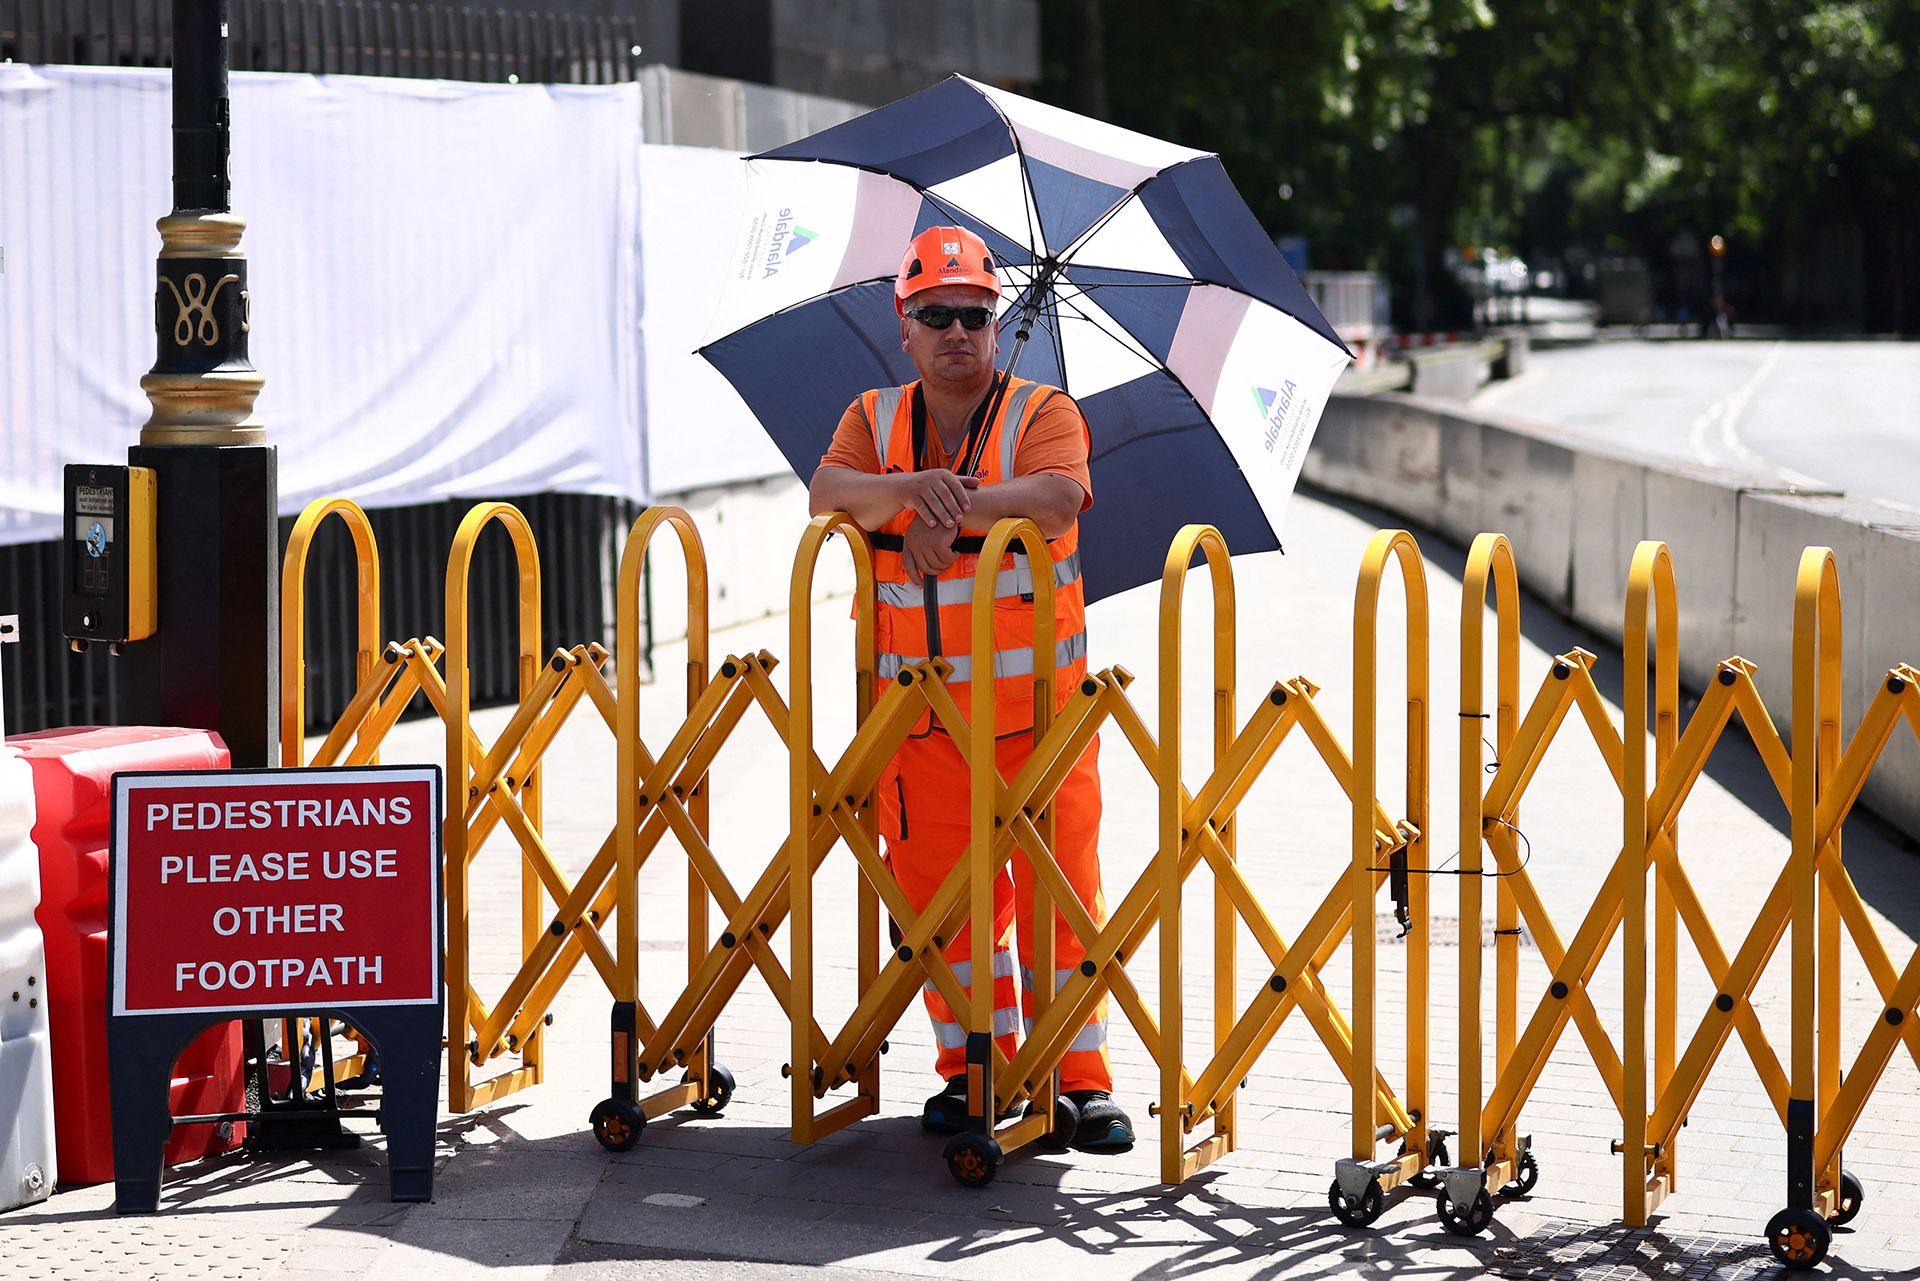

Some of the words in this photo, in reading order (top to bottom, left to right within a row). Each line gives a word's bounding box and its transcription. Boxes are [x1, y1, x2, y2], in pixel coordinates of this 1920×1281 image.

[147, 797, 412, 831] PEDESTRIANS
[161, 852, 310, 884] PLEASE
[323, 850, 398, 879] USE
[213, 904, 345, 936] OTHER
[176, 956, 382, 991] FOOTPATH
